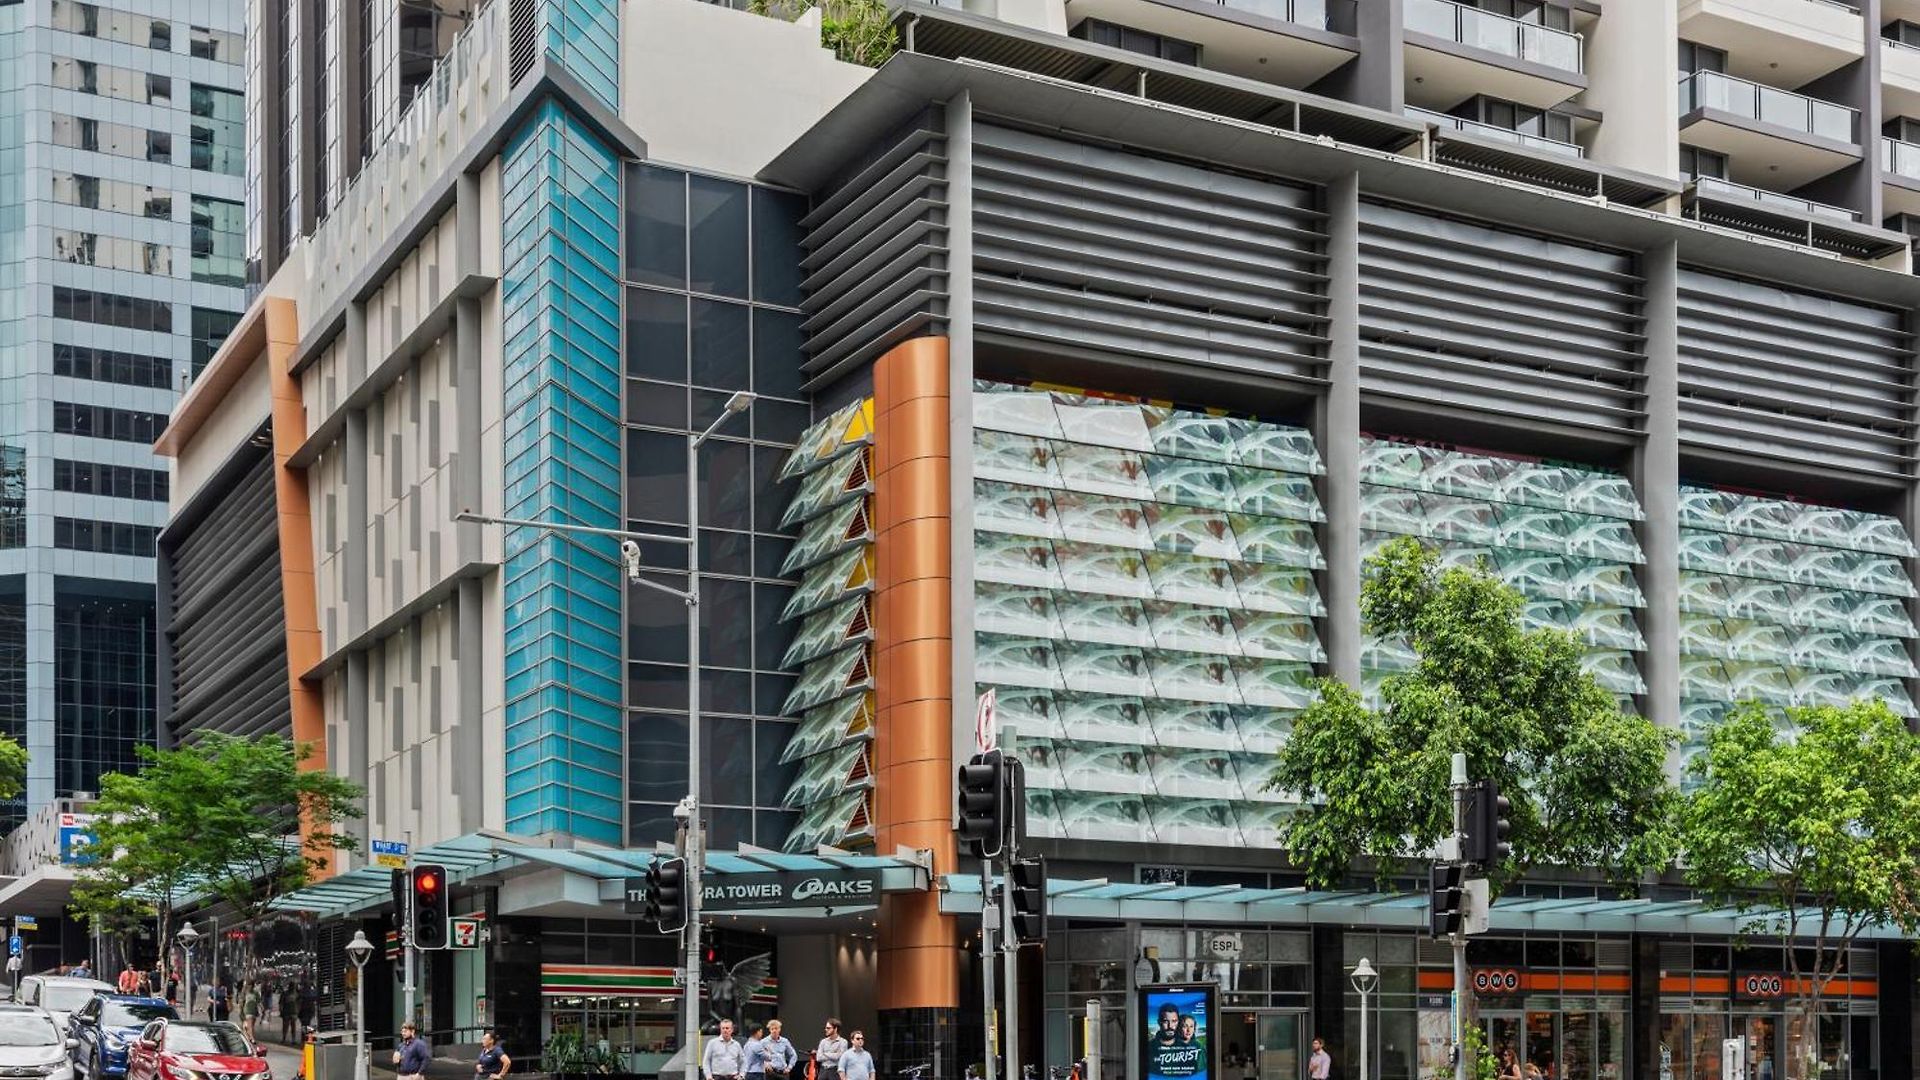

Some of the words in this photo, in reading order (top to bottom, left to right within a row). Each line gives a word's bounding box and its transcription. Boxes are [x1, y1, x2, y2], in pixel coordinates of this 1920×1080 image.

[627, 888, 647, 902] TH
[726, 883, 783, 898] TOWER
[791, 878, 873, 900] OAKS
[457, 924, 474, 945] 7
[1212, 940, 1239, 951] ESPL
[1478, 975, 1515, 987] BWS
[1159, 1048, 1202, 1065] TOURIST
